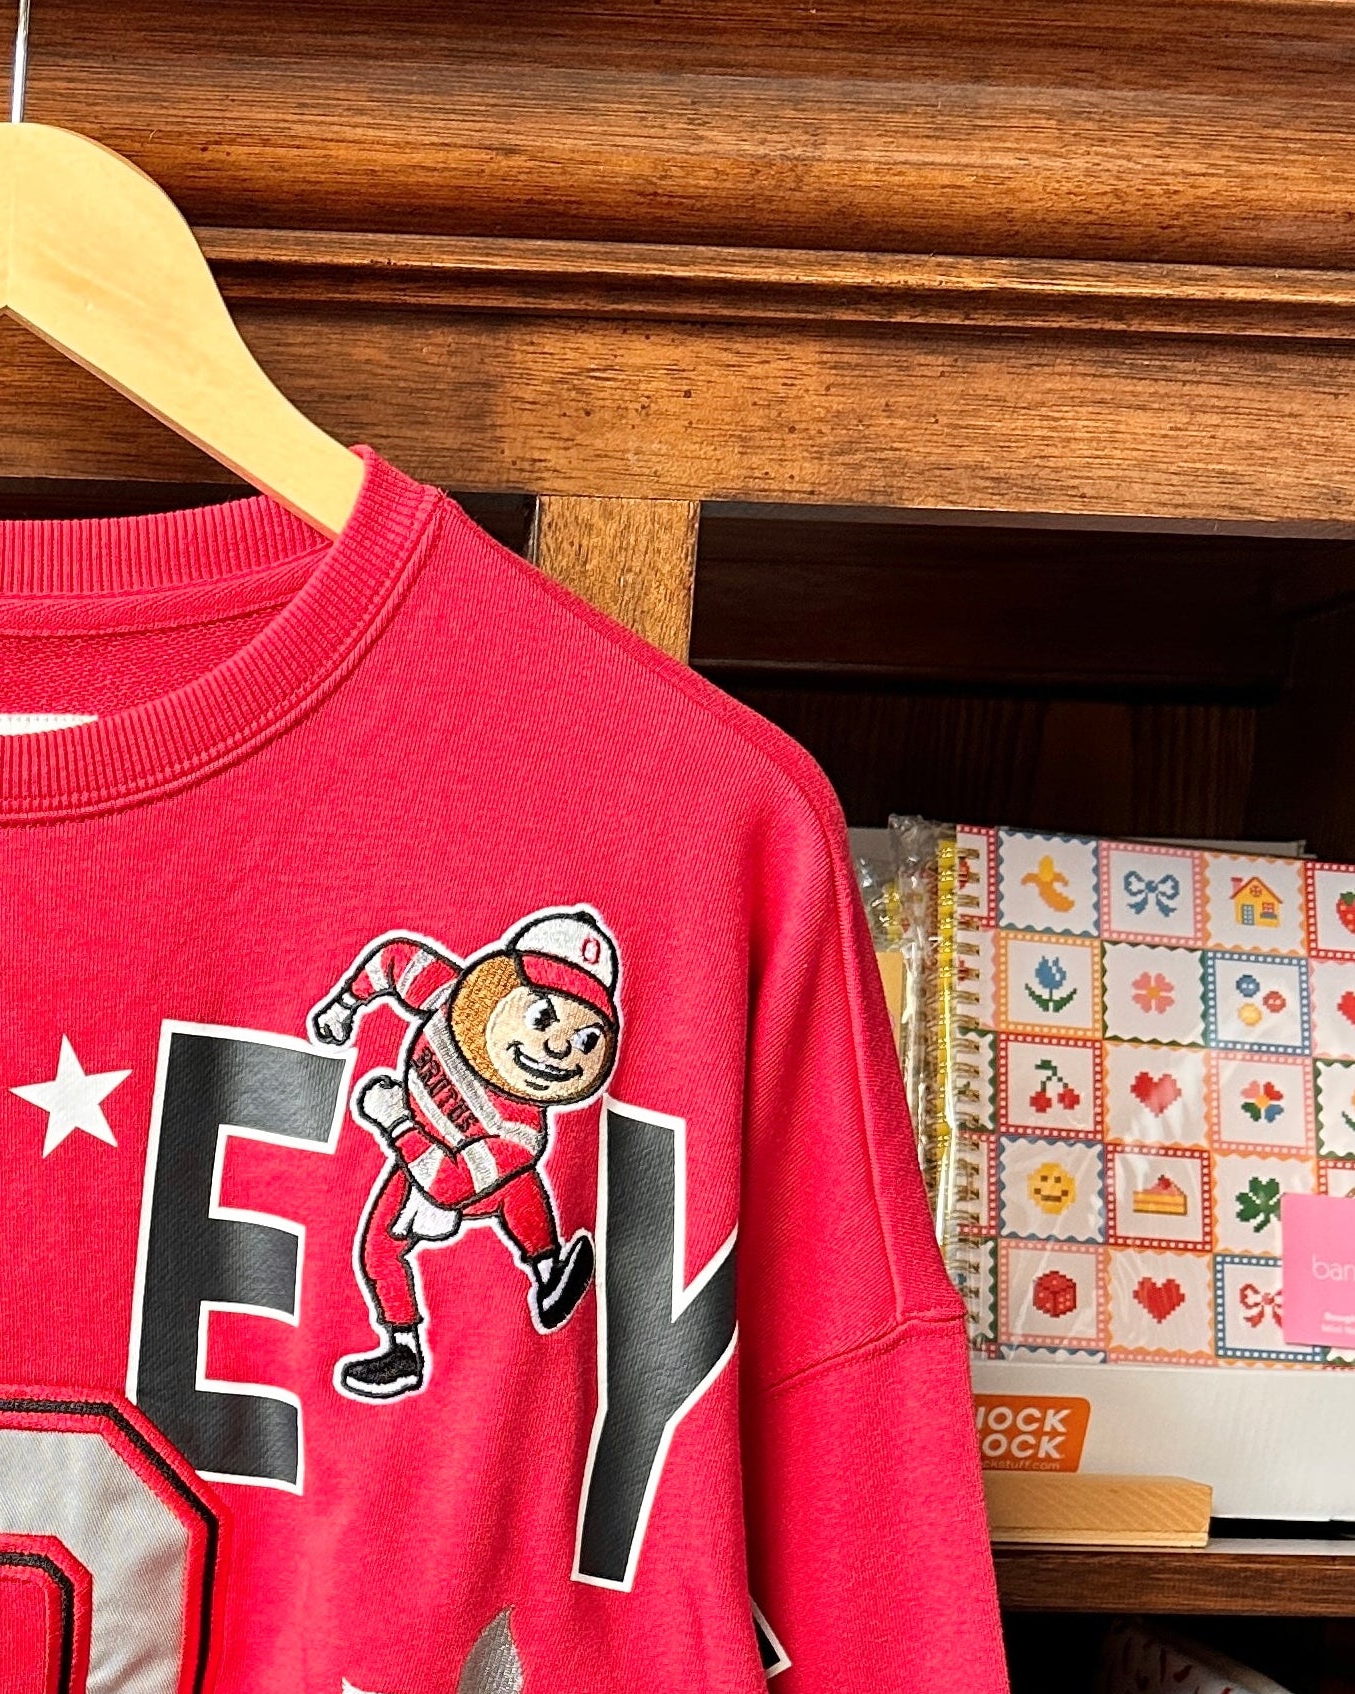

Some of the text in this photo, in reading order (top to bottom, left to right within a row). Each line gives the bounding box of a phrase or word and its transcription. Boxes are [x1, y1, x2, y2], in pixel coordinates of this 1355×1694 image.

[1312, 1254, 1355, 1281] ban
[975, 1406, 1071, 1433] OCK
[982, 1432, 1065, 1459] OCK
[982, 1460, 1061, 1471] ckstuff.com
